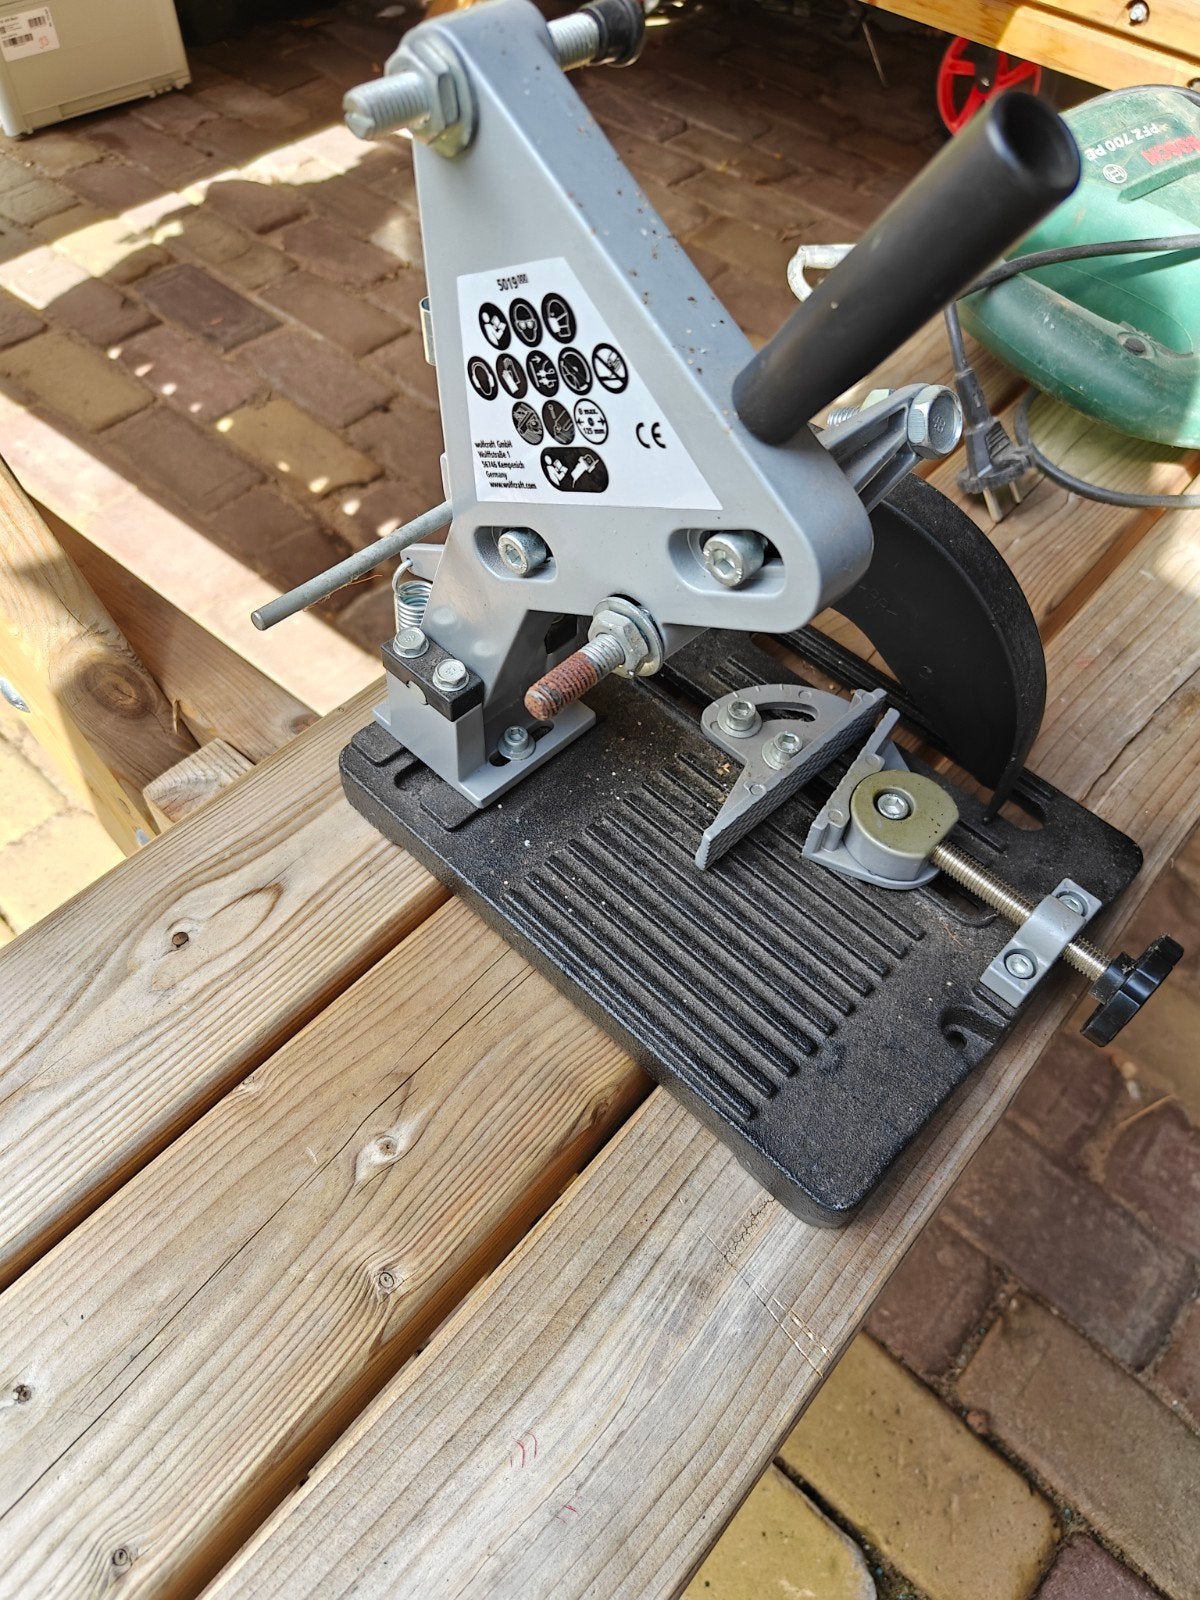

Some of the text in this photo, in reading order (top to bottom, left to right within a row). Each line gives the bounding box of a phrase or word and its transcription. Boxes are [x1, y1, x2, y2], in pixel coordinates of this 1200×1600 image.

[1130, 123, 1162, 141] PFZ
[1105, 133, 1133, 152] 700
[485, 470, 508, 480] Germany
[489, 480, 537, 489] www.wolfcraft.com
